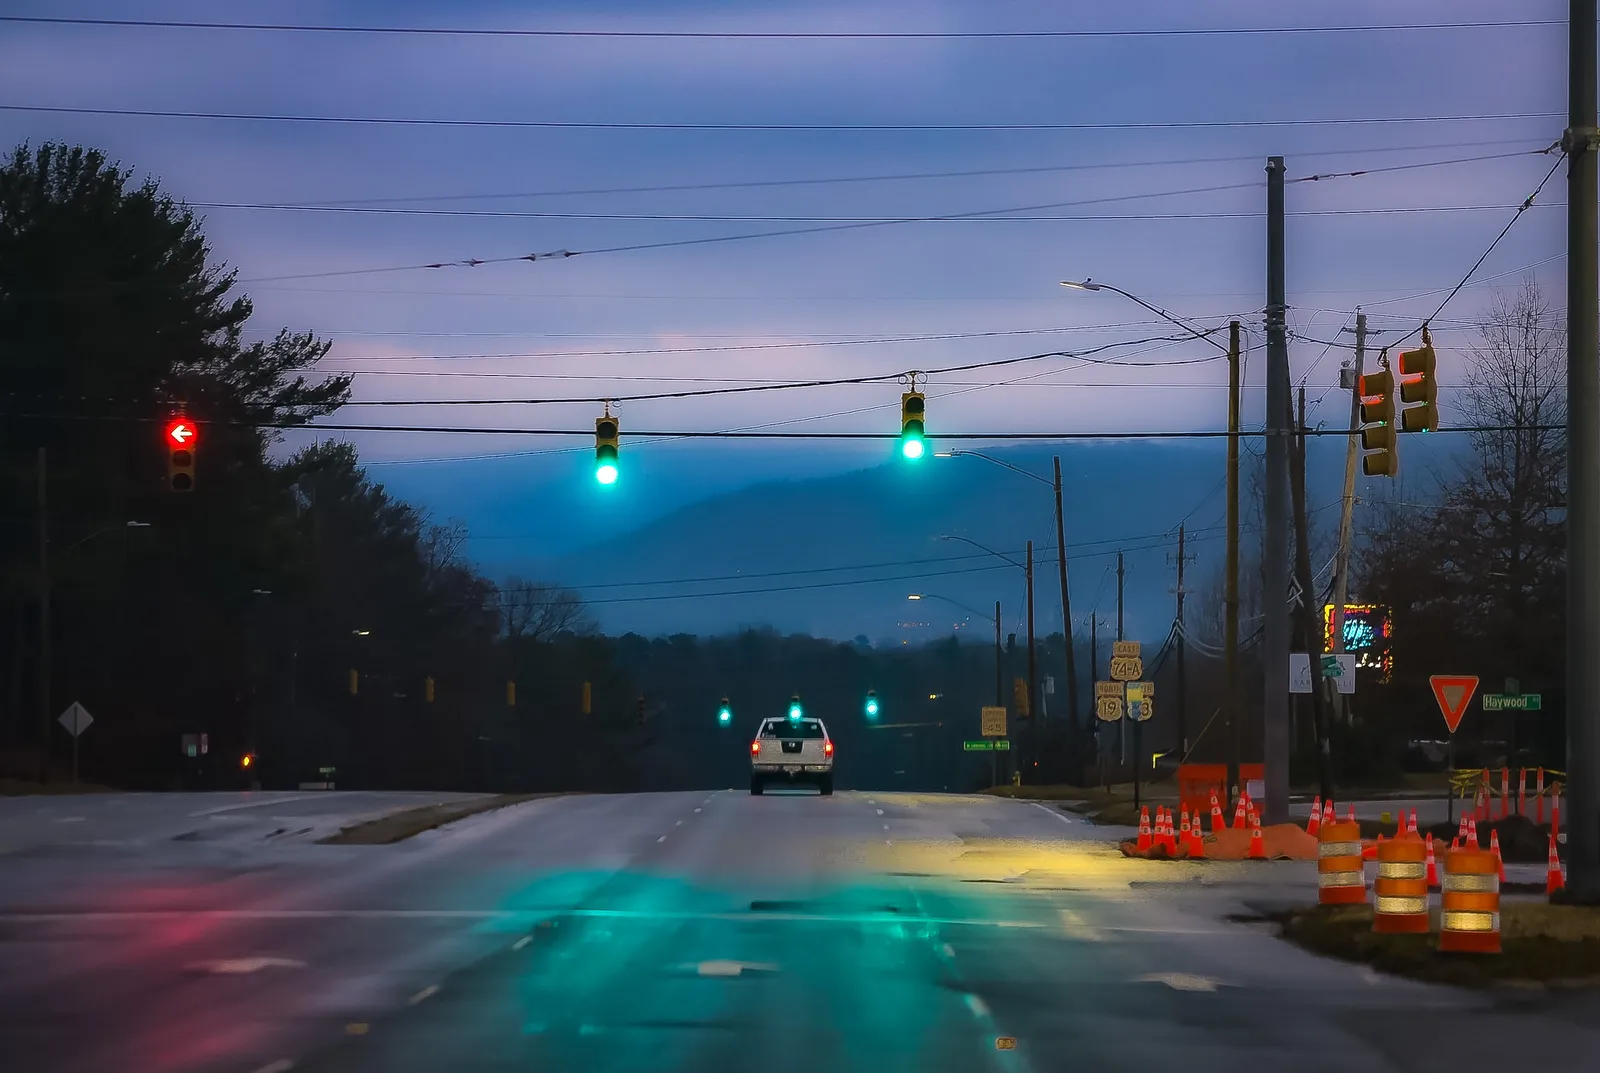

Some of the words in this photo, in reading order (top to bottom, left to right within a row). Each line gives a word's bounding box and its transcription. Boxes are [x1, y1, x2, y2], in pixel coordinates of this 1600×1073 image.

[1113, 661, 1140, 676] 74-A
[1103, 701, 1117, 715] 19
[1485, 696, 1527, 708] Haywood
